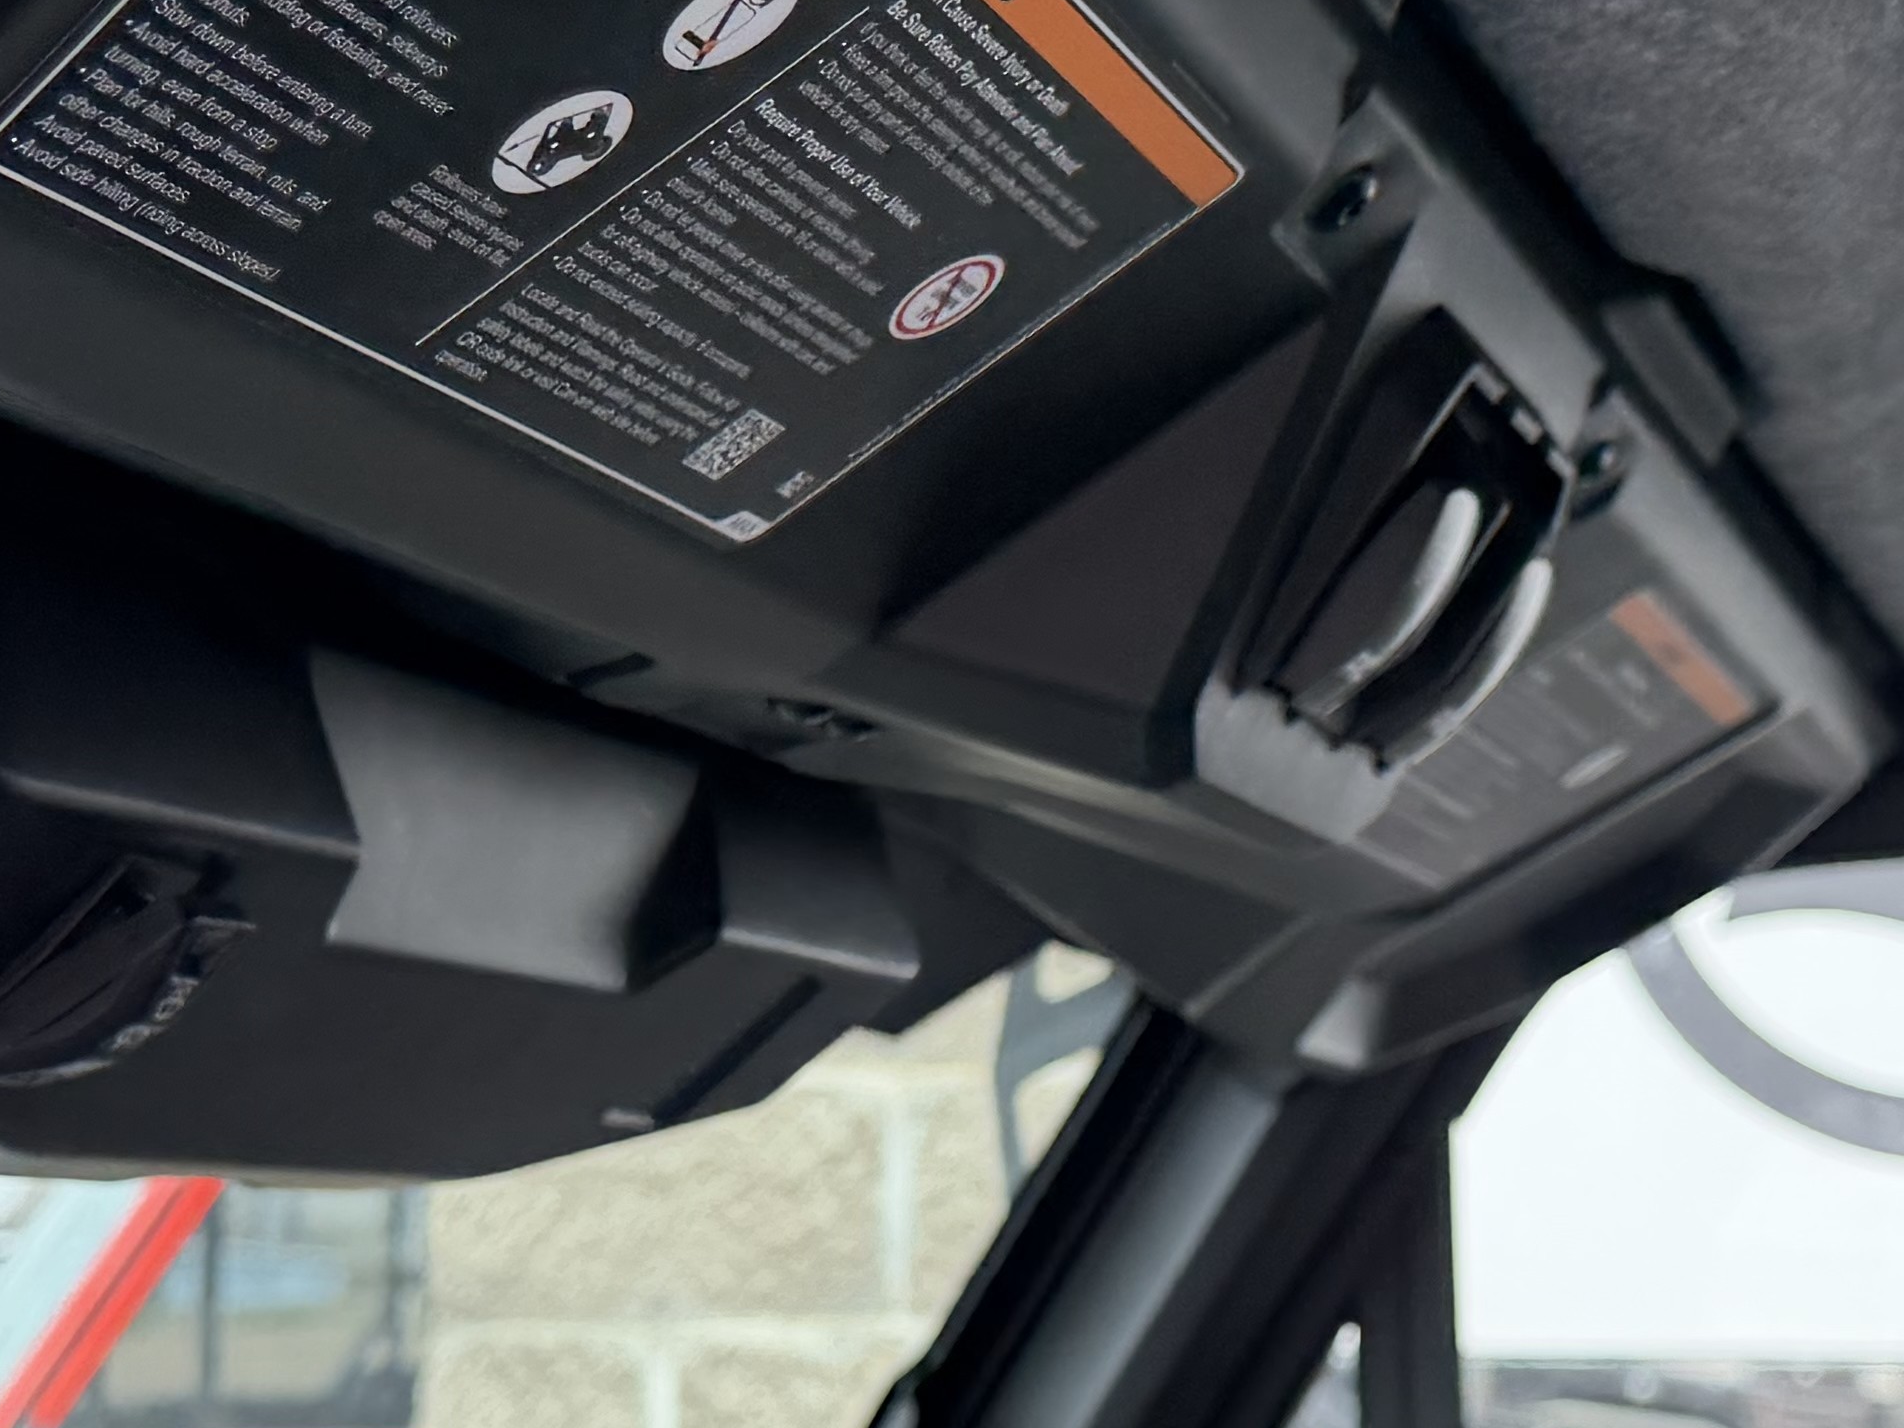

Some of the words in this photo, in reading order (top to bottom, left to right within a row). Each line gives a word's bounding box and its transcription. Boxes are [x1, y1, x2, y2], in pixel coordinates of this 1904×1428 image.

[128, 20, 181, 56] Avoid
[170, 45, 216, 76] hard
[205, 67, 294, 124] acceleration
[287, 116, 331, 146] when
[190, 21, 237, 54] down
[230, 43, 282, 81] before
[329, 108, 346, 121] a
[306, 19, 330, 37] or
[385, 70, 421, 95] and
[411, 88, 455, 117] never
[384, 32, 450, 79] sideways
[900, 11, 934, 42] Sure
[923, 32, 964, 69] Riders
[952, 59, 982, 88] Pay
[1024, 78, 1045, 94] or
[33, 113, 88, 146] Avoid
[73, 137, 134, 171] paved
[58, 91, 107, 121] other
[96, 113, 167, 155] changes
[159, 147, 182, 163] in
[176, 154, 234, 194] traction
[227, 185, 265, 208] and
[82, 67, 126, 98] Plan
[119, 87, 148, 109] for
[173, 120, 224, 154] rough
[295, 189, 332, 212] and
[159, 78, 202, 107] even
[196, 96, 237, 125] from
[229, 119, 247, 132] a
[752, 97, 803, 139] Require
[793, 128, 839, 165] Proper
[828, 155, 857, 179] Use
[848, 172, 872, 188] of
[860, 178, 891, 205] Your
[13, 137, 68, 170] Avoid
[58, 161, 98, 186] side
[180, 226, 231, 257] across
